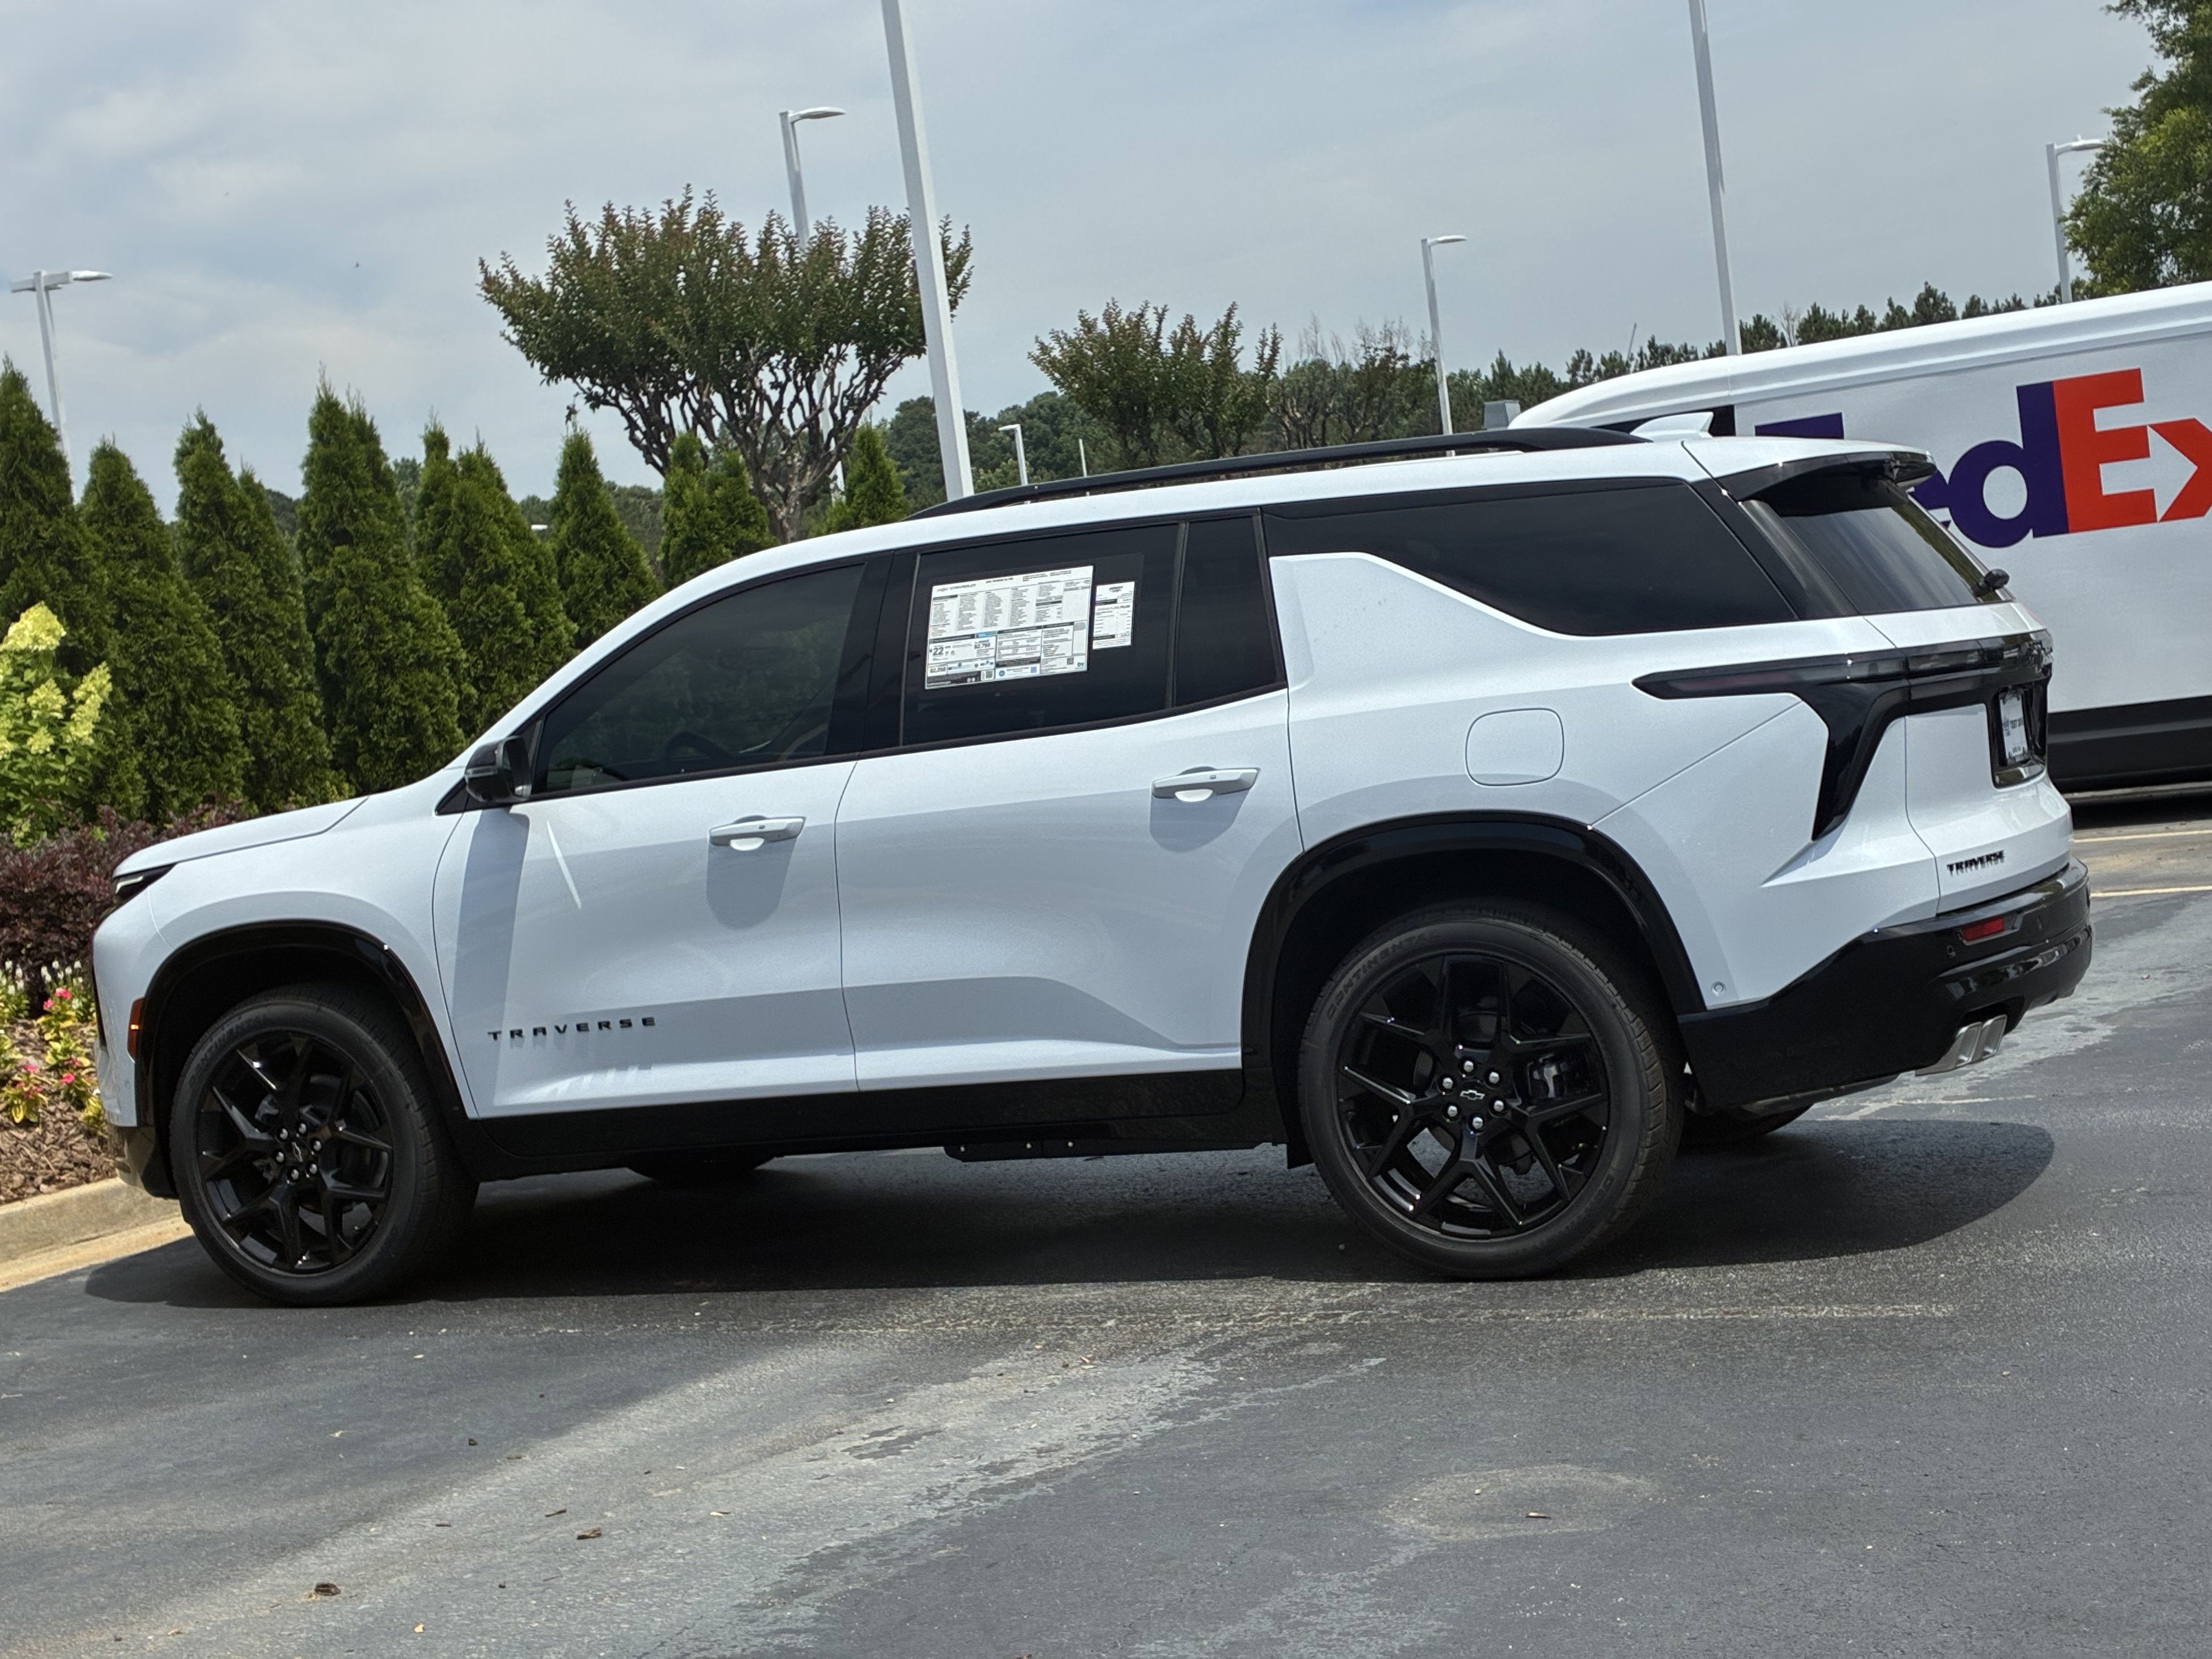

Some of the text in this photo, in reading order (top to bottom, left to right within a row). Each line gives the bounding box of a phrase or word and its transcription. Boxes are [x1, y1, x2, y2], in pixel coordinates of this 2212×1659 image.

[933, 647, 944, 656] 22
[1946, 850, 2005, 872] TRAVERSE
[487, 1017, 656, 1041] TRAVERSE
